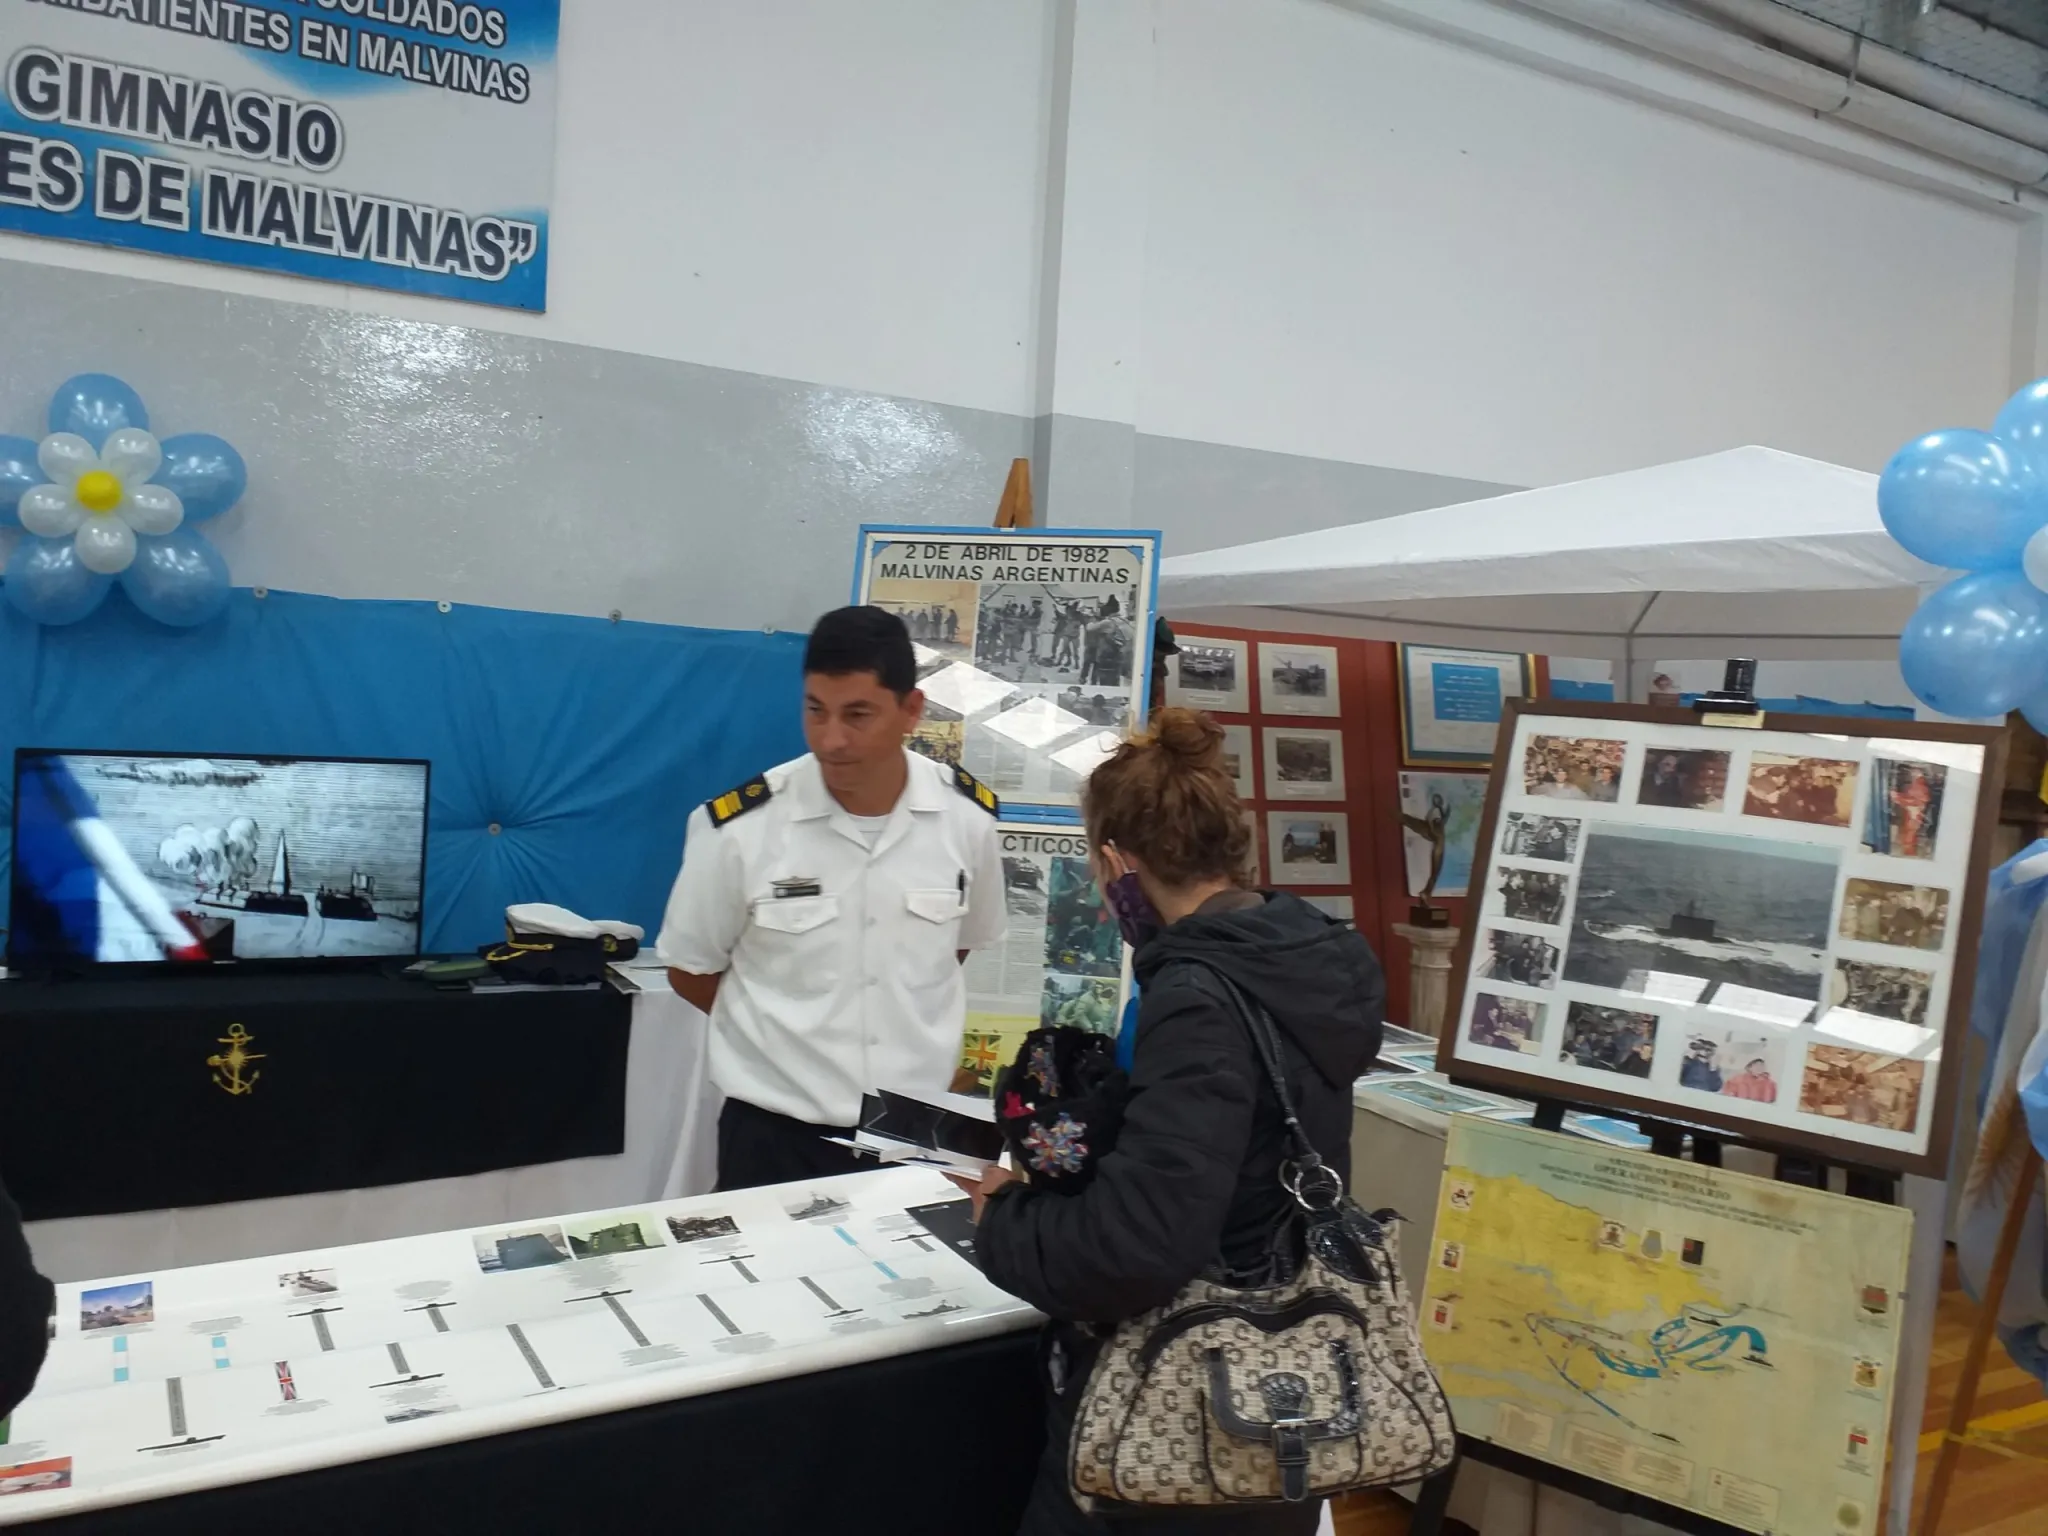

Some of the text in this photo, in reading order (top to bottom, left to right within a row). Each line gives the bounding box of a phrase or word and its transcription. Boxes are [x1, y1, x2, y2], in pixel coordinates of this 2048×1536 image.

[301, 19, 349, 64] EN
[359, 32, 530, 102] MALVINAS
[13, 52, 341, 168] GIMNASIO
[100, 152, 187, 226] DE
[880, 563, 1130, 584] MALVINAS ARGENTINAS
[905, 545, 1110, 563] 2 DE ABRIL DE 1982
